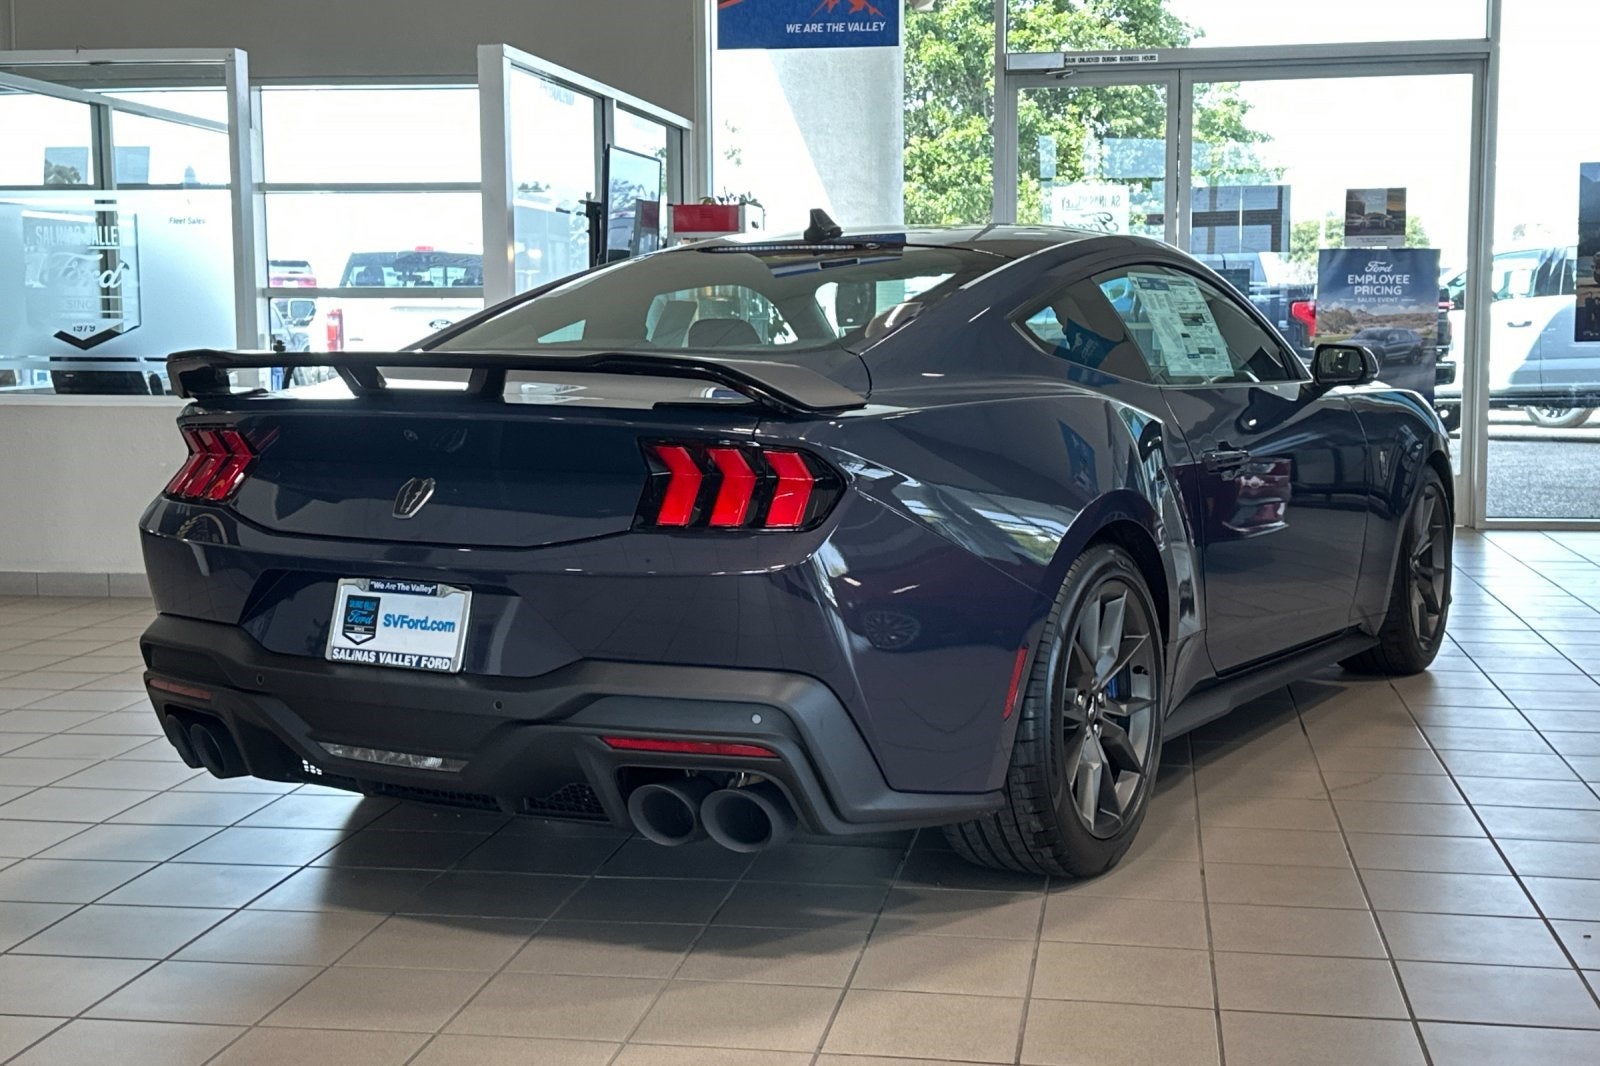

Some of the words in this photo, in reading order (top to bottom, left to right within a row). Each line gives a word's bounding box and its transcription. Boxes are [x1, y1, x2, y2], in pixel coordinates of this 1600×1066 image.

[786, 23, 802, 33] WE
[803, 23, 824, 33] ARE
[826, 22, 846, 32] THE
[847, 21, 886, 32] VALLEY
[1364, 260, 1393, 273] Ford
[1347, 273, 1411, 285] EMPLOYEE
[1354, 285, 1402, 296] PRICING
[384, 582, 397, 591] Are
[397, 583, 410, 591] The
[347, 609, 375, 625] Ford
[383, 613, 455, 632] SVFord.com
[332, 647, 376, 663] SALINAS
[379, 651, 417, 667] VALLEY
[420, 656, 450, 670] FORD
